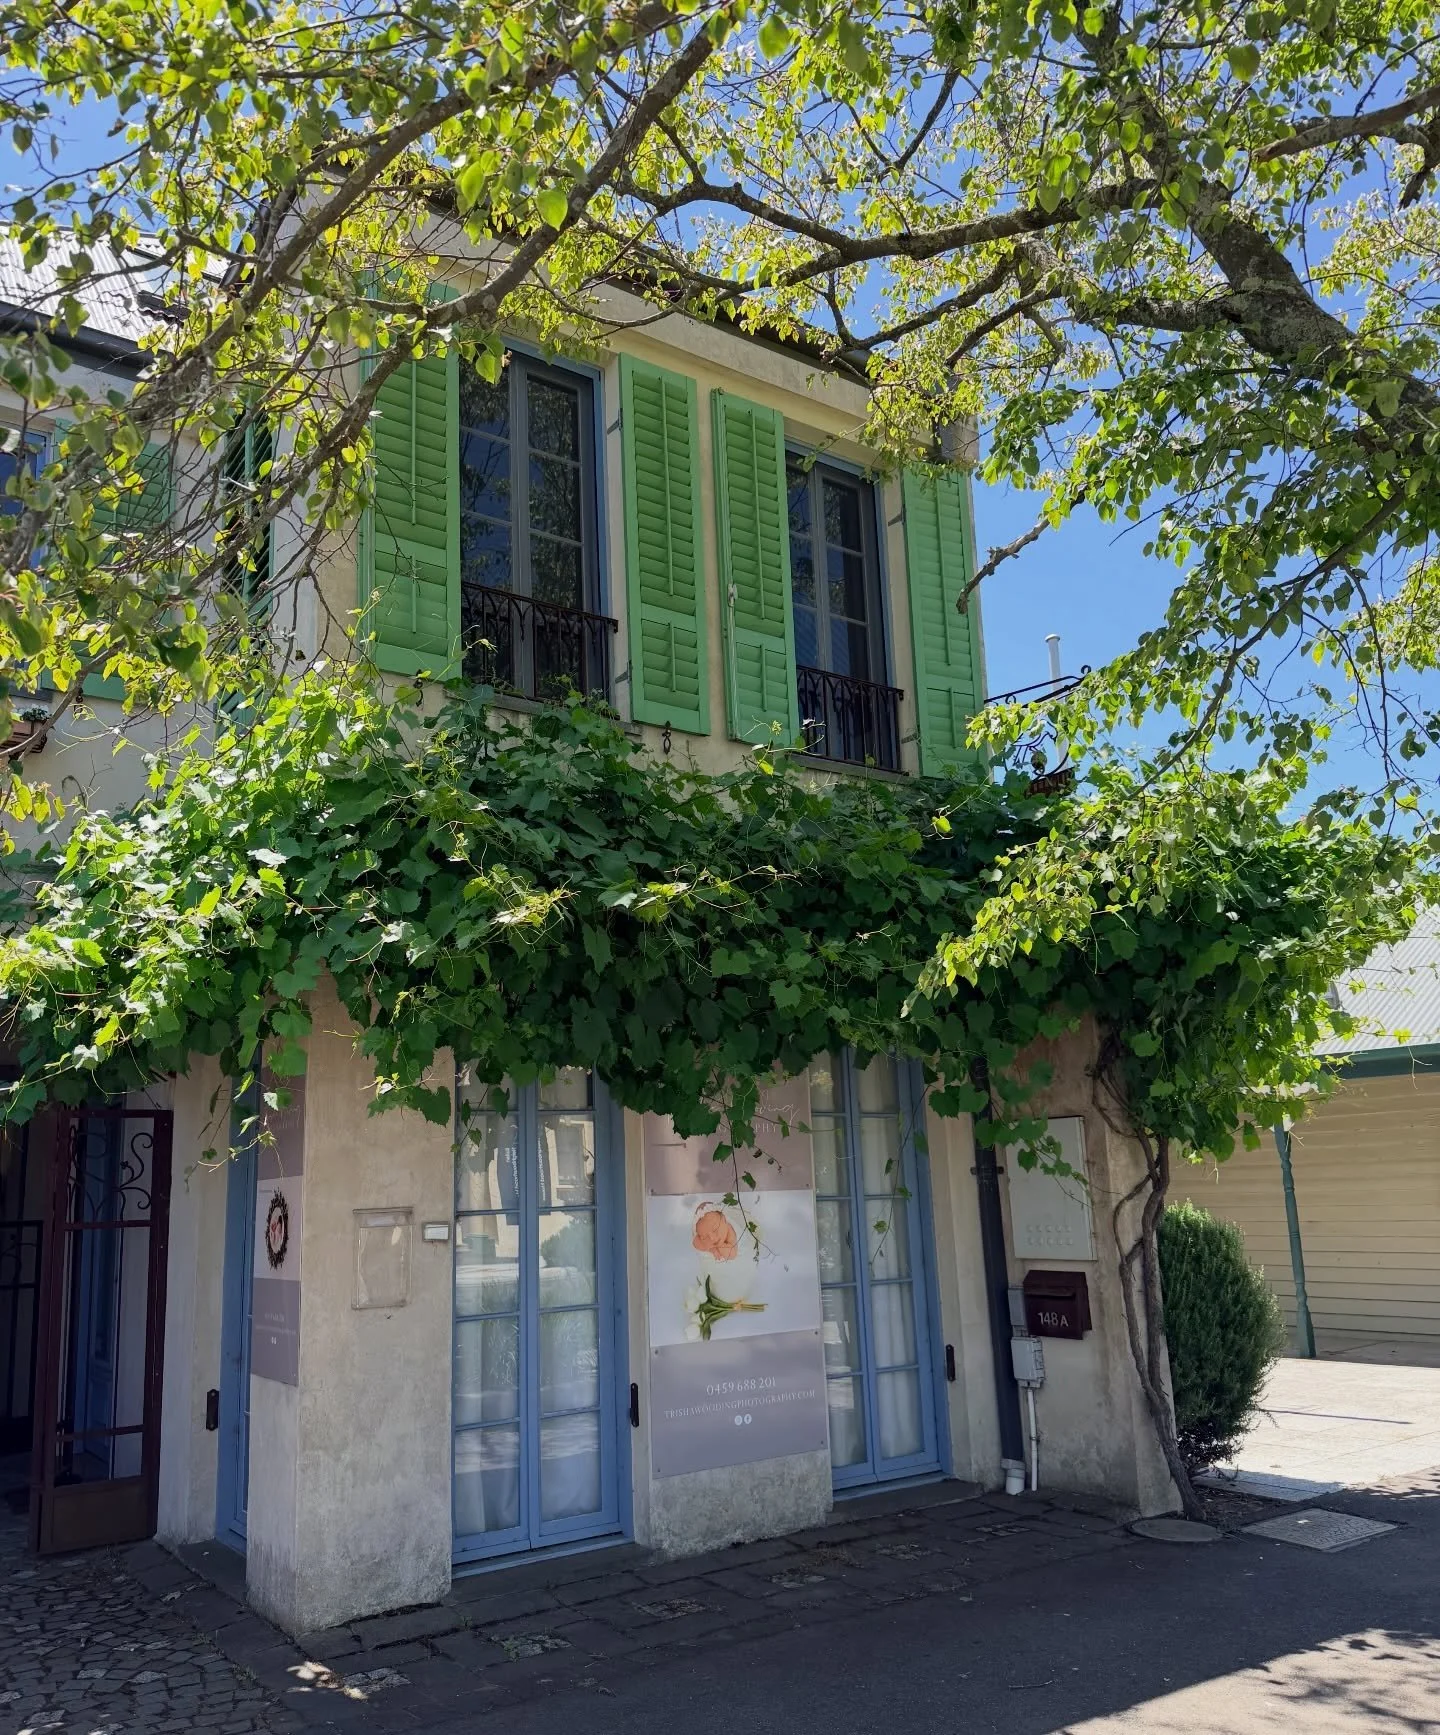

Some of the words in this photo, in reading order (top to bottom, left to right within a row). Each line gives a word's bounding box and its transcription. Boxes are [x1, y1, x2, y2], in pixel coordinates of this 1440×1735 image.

[706, 1382, 734, 1396] 0459
[737, 1379, 756, 1391] 688
[759, 1376, 776, 1388] 201
